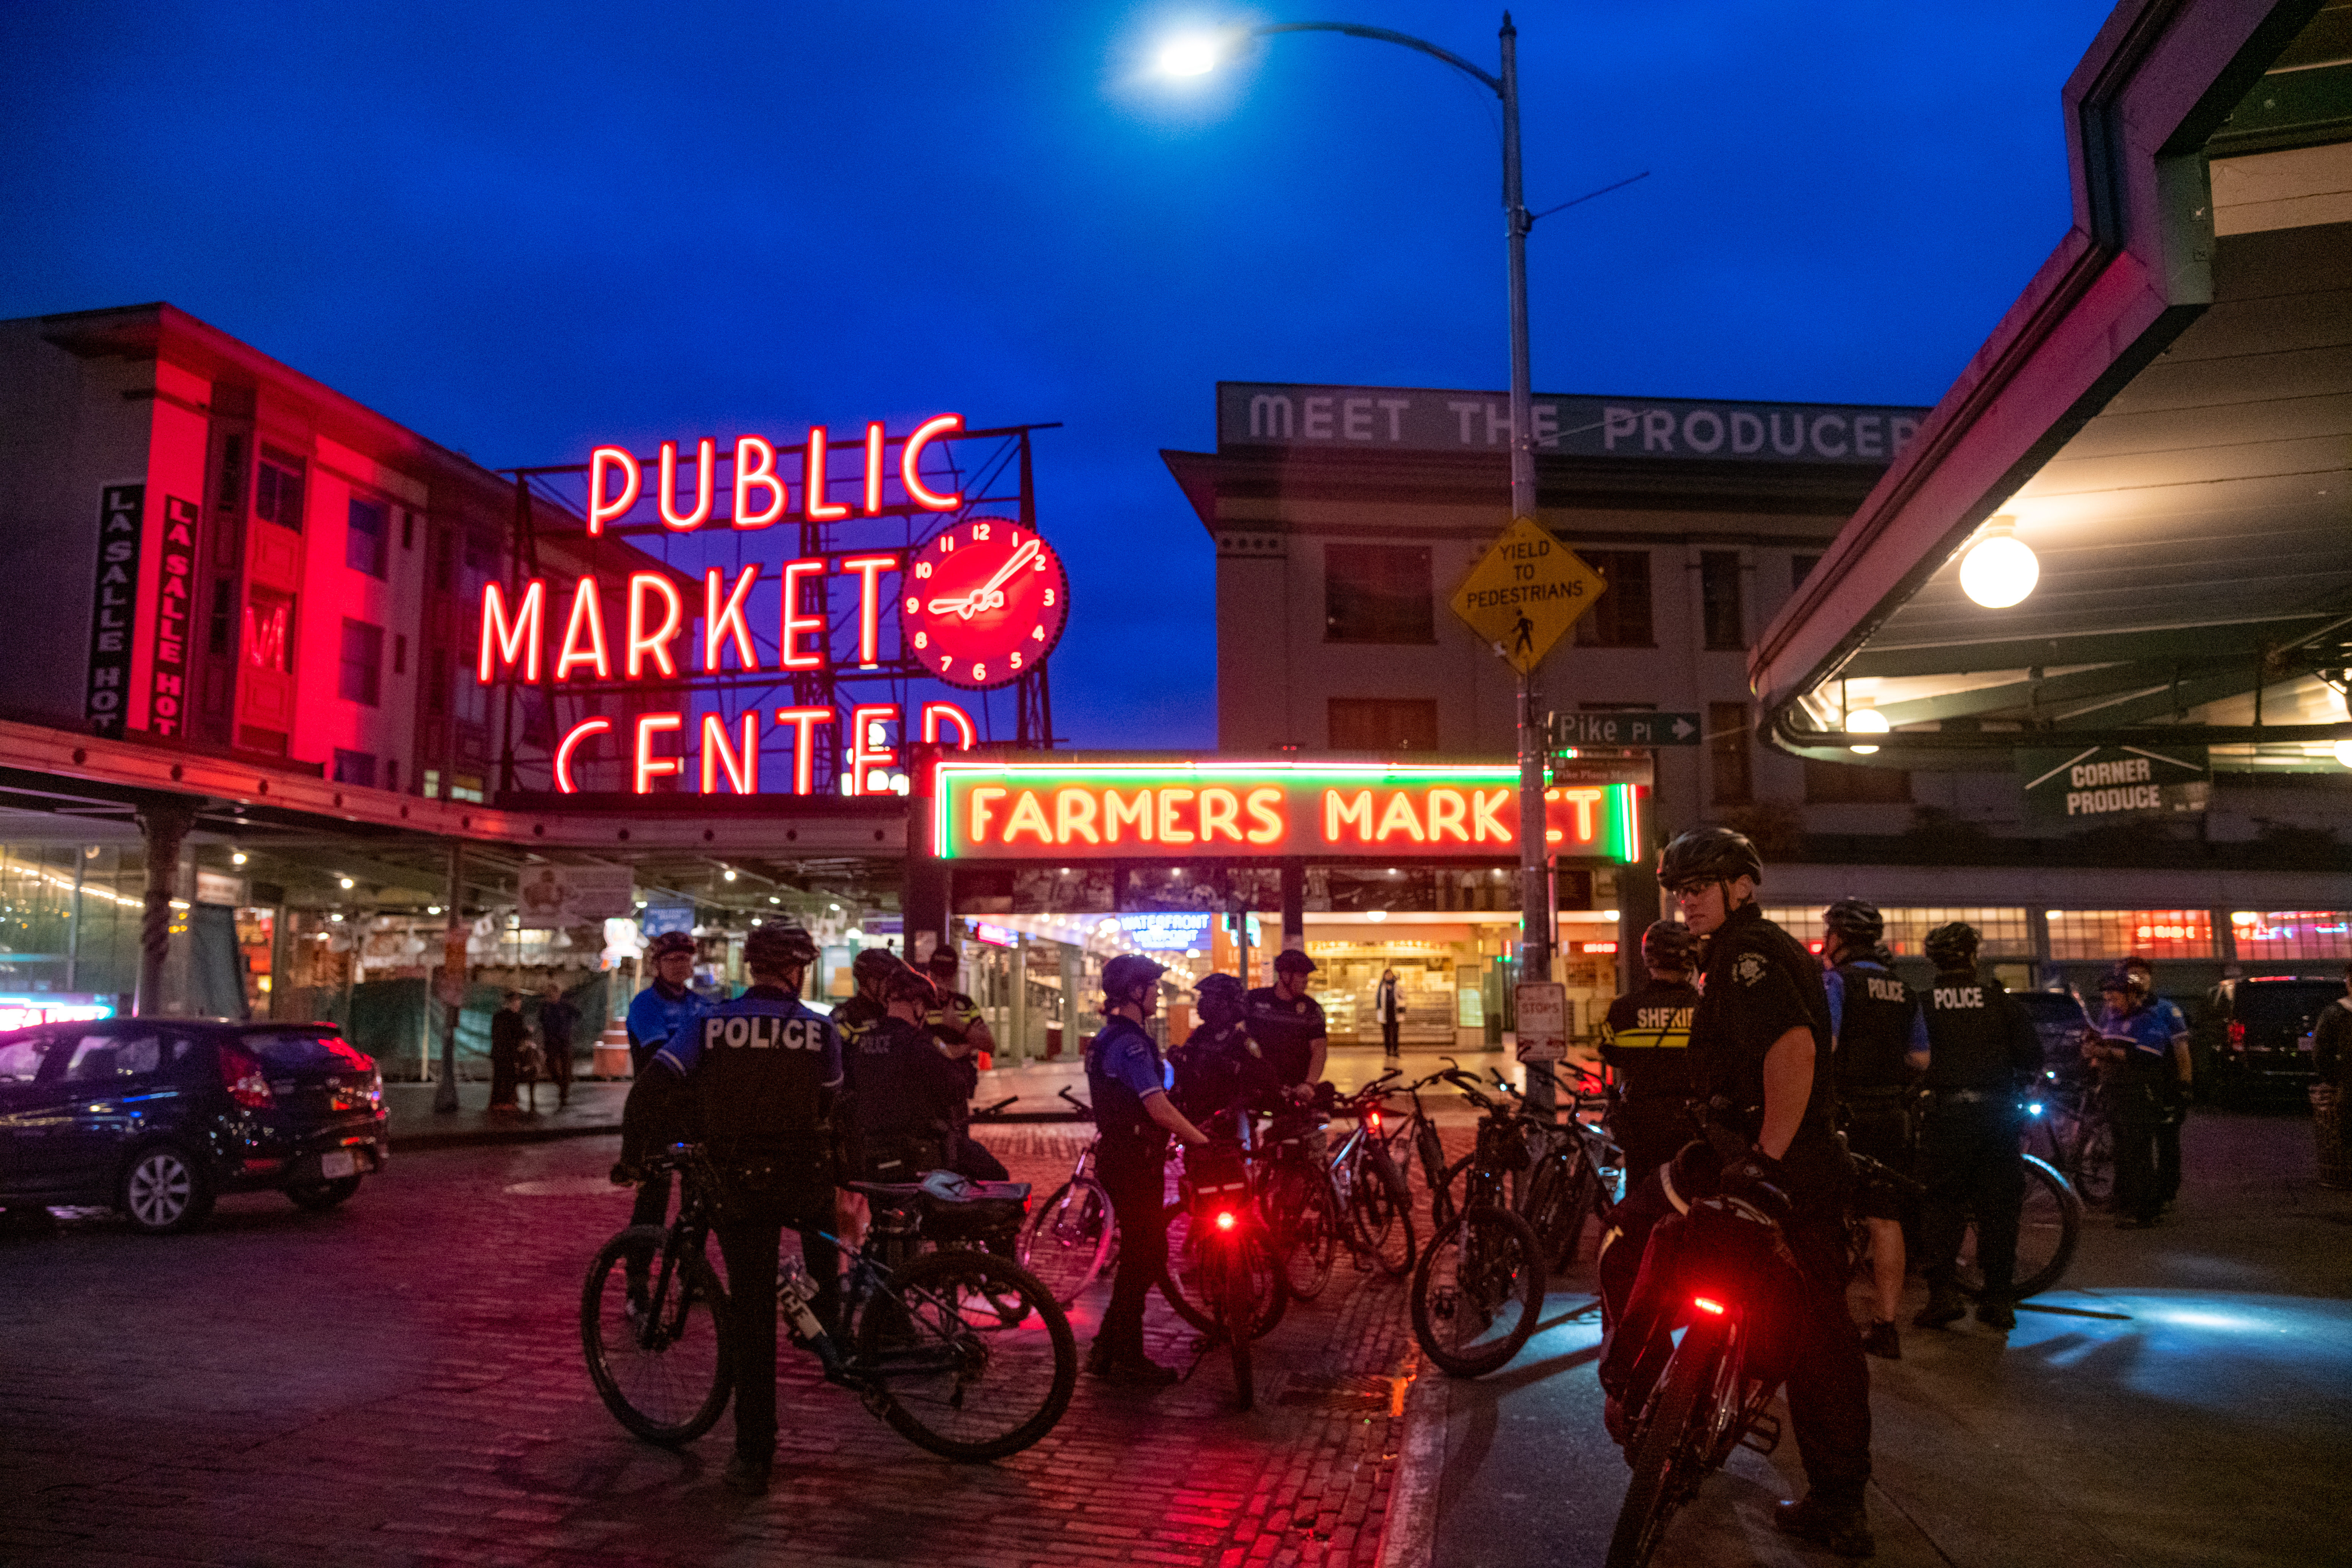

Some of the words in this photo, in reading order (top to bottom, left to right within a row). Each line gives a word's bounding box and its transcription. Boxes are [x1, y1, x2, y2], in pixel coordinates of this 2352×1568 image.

[1248, 394, 1411, 442] MEET
[1447, 400, 1559, 447] THE
[588, 413, 965, 537] PUBLIC
[106, 492, 136, 533] LA
[169, 500, 193, 545] LA
[971, 523, 991, 541] 12
[1011, 531, 1020, 547] 1
[940, 536, 955, 552] 11
[1499, 539, 1551, 561] YIELD
[914, 561, 932, 579] 10
[1034, 554, 1046, 572] 2
[1513, 563, 1536, 582] TO
[99, 542, 133, 651] SALLE
[906, 597, 920, 614] 9
[1043, 588, 1055, 607] 3
[1466, 580, 1584, 609] PEDESTRIANS
[159, 556, 188, 664] SALLE
[477, 553, 901, 684] MARKET
[914, 631, 928, 649] 8
[1032, 624, 1046, 642] 4
[940, 655, 953, 671] 7
[1010, 651, 1023, 669] 5
[972, 663, 986, 681] 6
[1560, 716, 1618, 741] Pike
[1632, 722, 1652, 741] Pl
[2071, 758, 2151, 788] CORNER
[2067, 784, 2161, 816] PRODUCE
[969, 788, 1283, 845] FARMERS
[1121, 914, 1209, 930] WATERFRONT
[1867, 977, 1906, 1003] POLICE
[1933, 987, 1984, 1010] POLICE
[705, 1016, 822, 1052] POLICE
